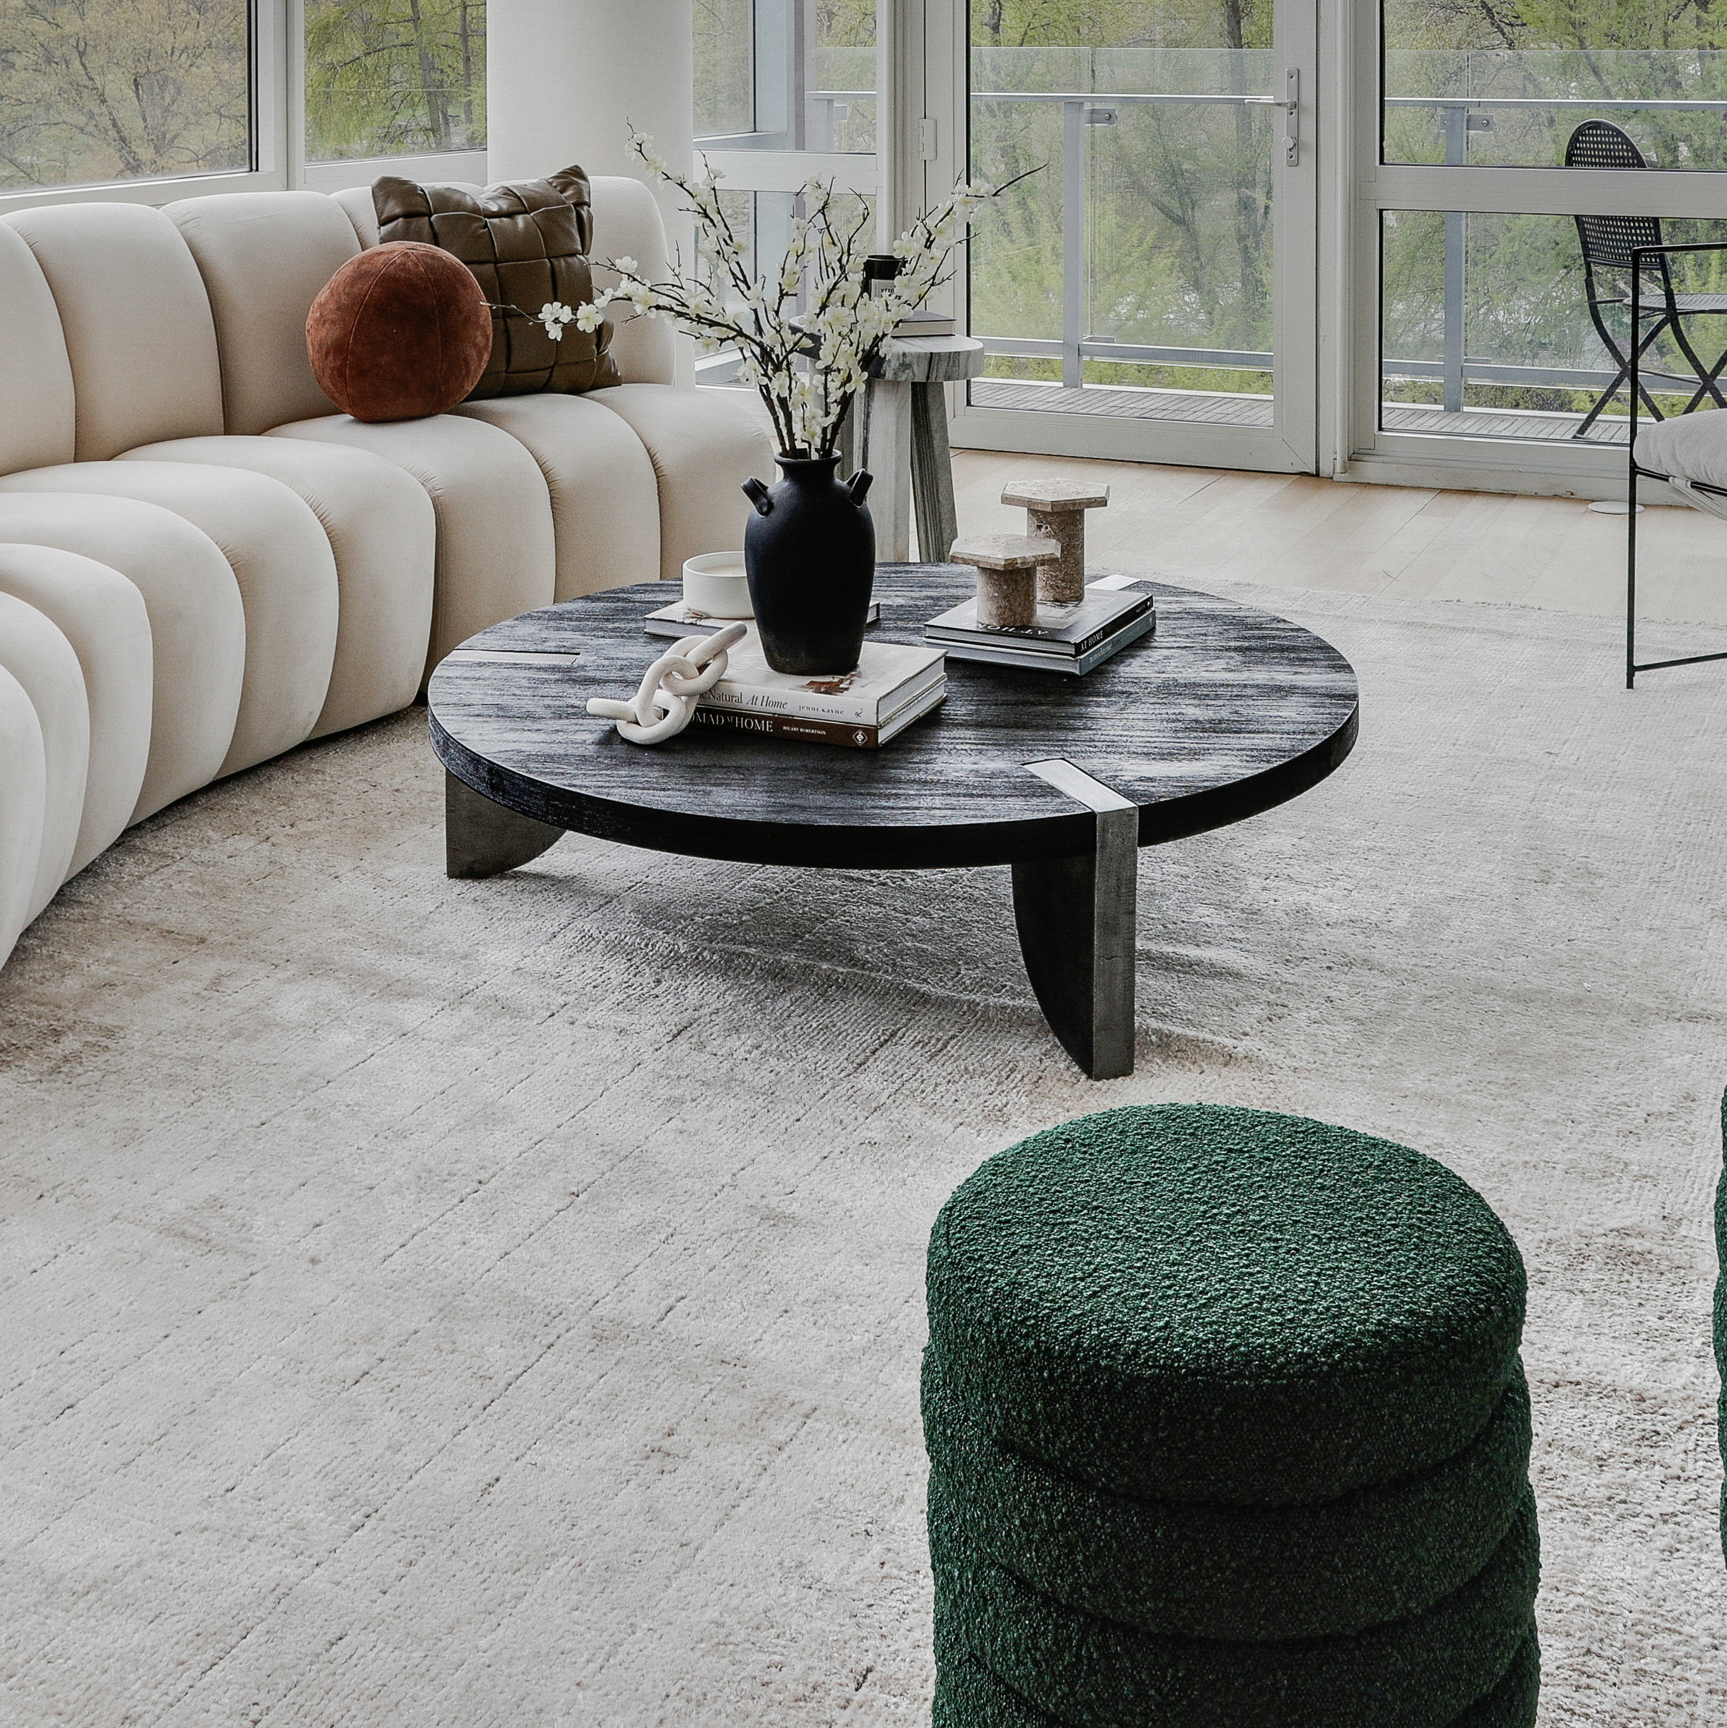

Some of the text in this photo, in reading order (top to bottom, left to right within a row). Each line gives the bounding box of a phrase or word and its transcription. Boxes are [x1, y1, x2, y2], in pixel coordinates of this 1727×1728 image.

[746, 695, 757, 706] At
[760, 695, 788, 710] Home
[735, 716, 774, 732] HOME
